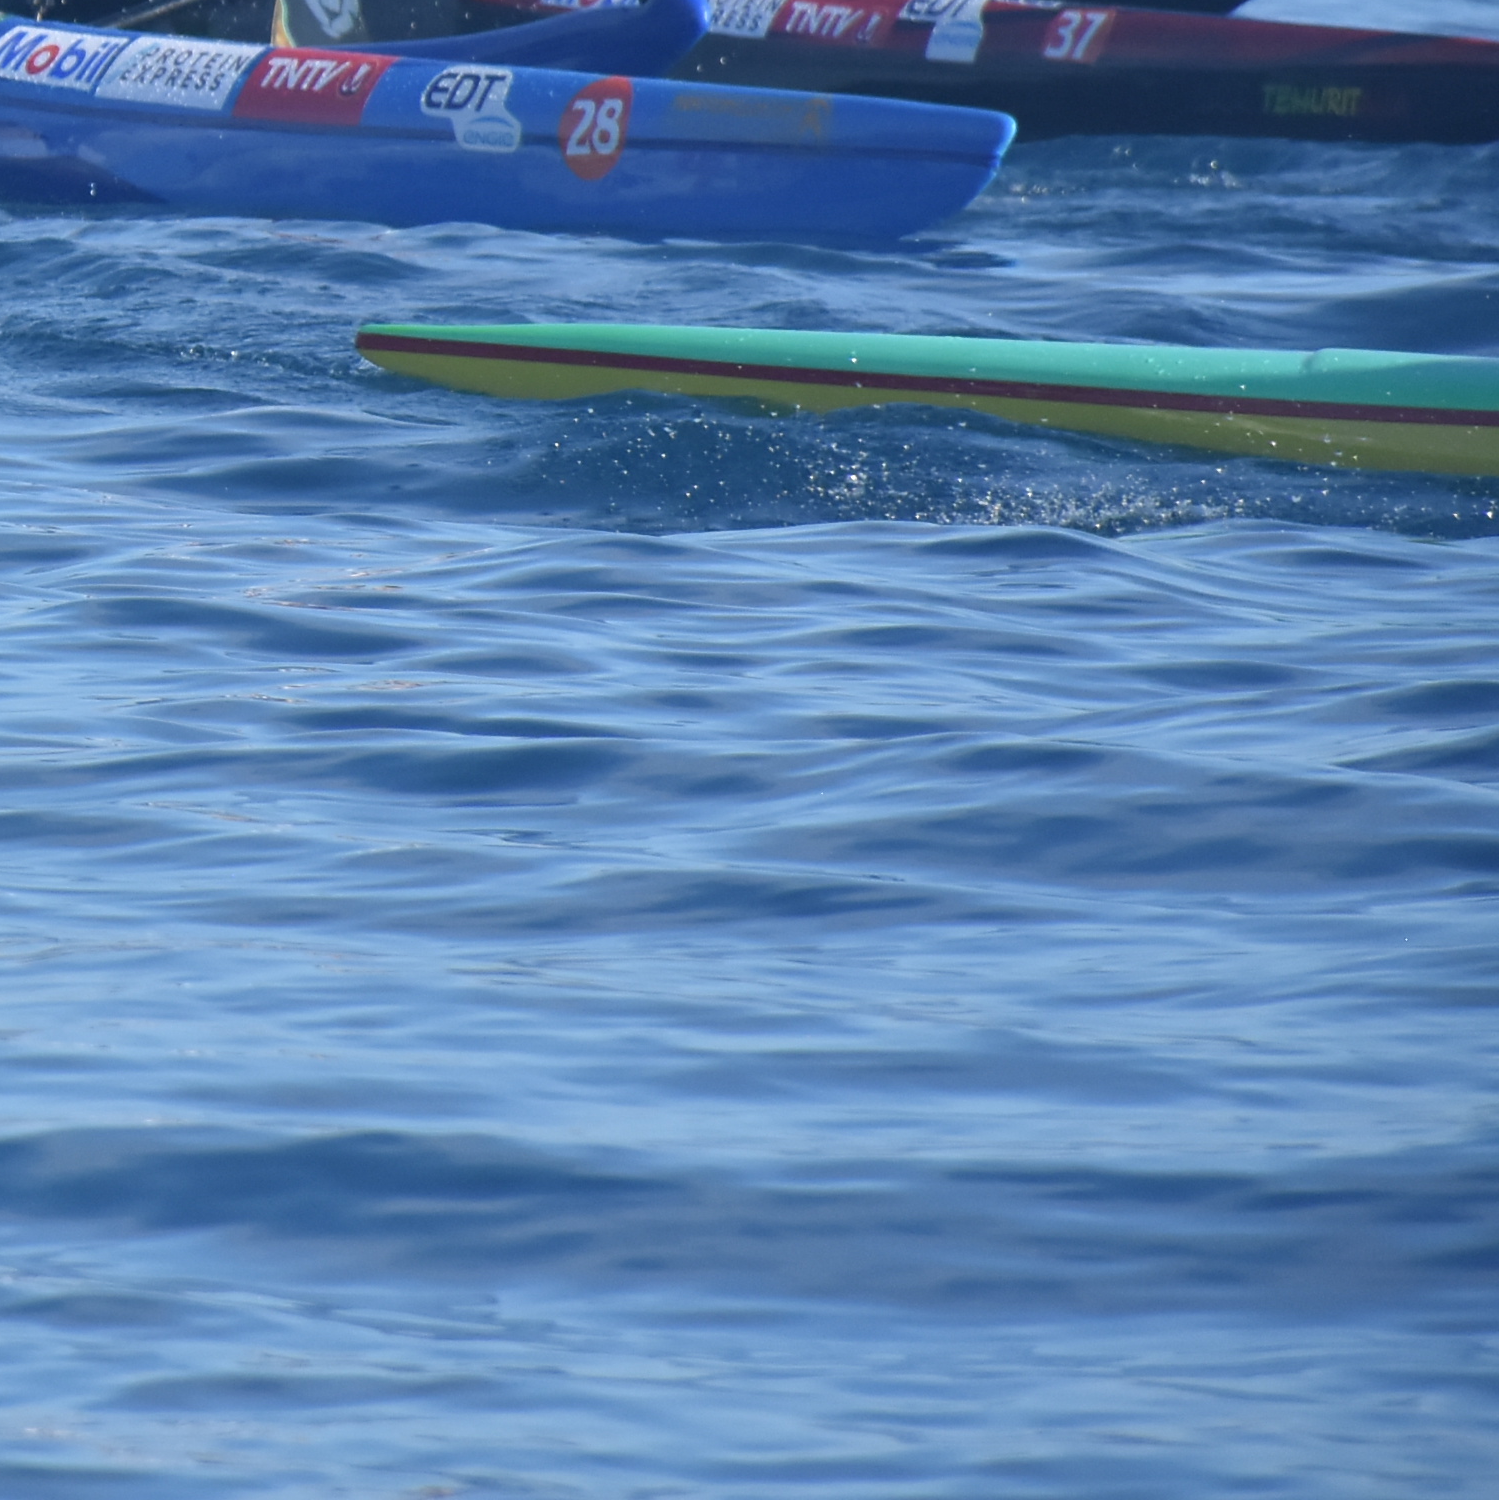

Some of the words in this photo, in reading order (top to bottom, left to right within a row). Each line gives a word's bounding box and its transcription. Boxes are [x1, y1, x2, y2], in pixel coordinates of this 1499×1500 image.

[1043, 9, 1108, 60] 37
[260, 56, 349, 92] TNTV
[424, 71, 509, 112] EDT
[565, 98, 624, 156] 28
